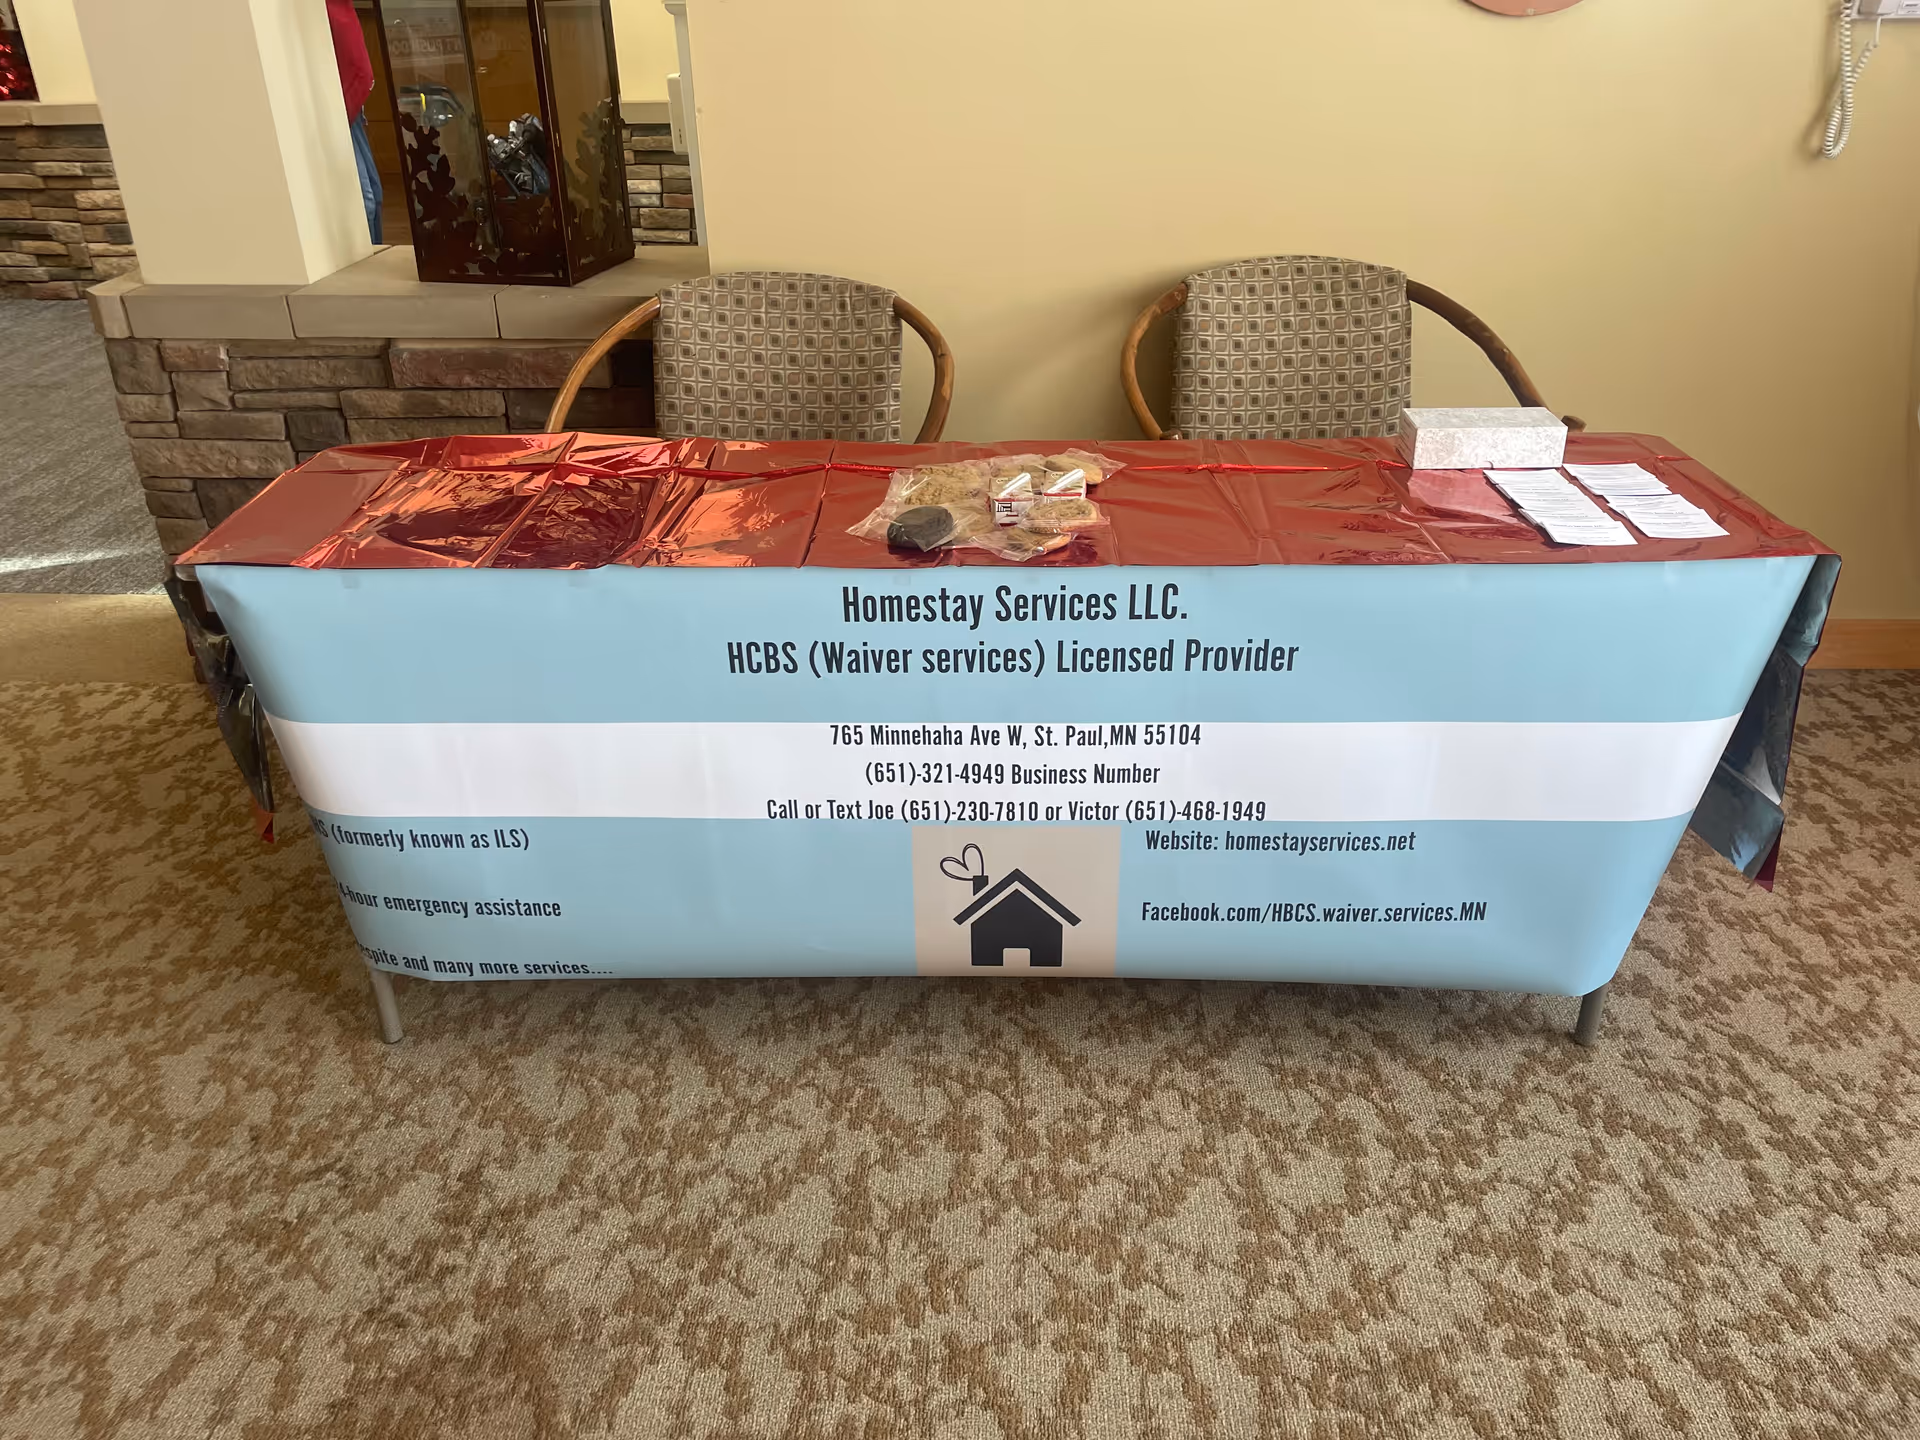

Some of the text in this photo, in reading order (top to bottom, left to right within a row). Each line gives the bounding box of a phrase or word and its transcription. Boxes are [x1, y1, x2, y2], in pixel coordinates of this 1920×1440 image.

[842, 583, 1188, 631] Homestay Services LLC.
[727, 638, 1300, 679] HCBS (Waiver services) Licensed Provider
[829, 724, 864, 746] 765
[870, 724, 963, 746] Minnehaha
[970, 724, 1001, 746] Ave
[1007, 724, 1027, 750] W,
[1034, 724, 1058, 747] St.
[1143, 723, 1201, 746] 55104
[865, 761, 1161, 786] (651)-321-4949 Business Number
[766, 799, 1266, 825] Call or Text Joe (651)-230-7810 or Victor (651)-468-1949
[330, 823, 405, 853] (formerly
[408, 828, 466, 849] known
[469, 833, 490, 849] as
[493, 827, 530, 851] ILS)
[1145, 830, 1417, 856] Website: homestayservices.net
[335, 880, 562, 919] 4-hour emergency assistance
[1142, 901, 1487, 924] Facebook.com/HBCS.waiver.services.MN
[402, 955, 430, 972] and
[432, 960, 474, 977] many
[478, 962, 520, 975] more
